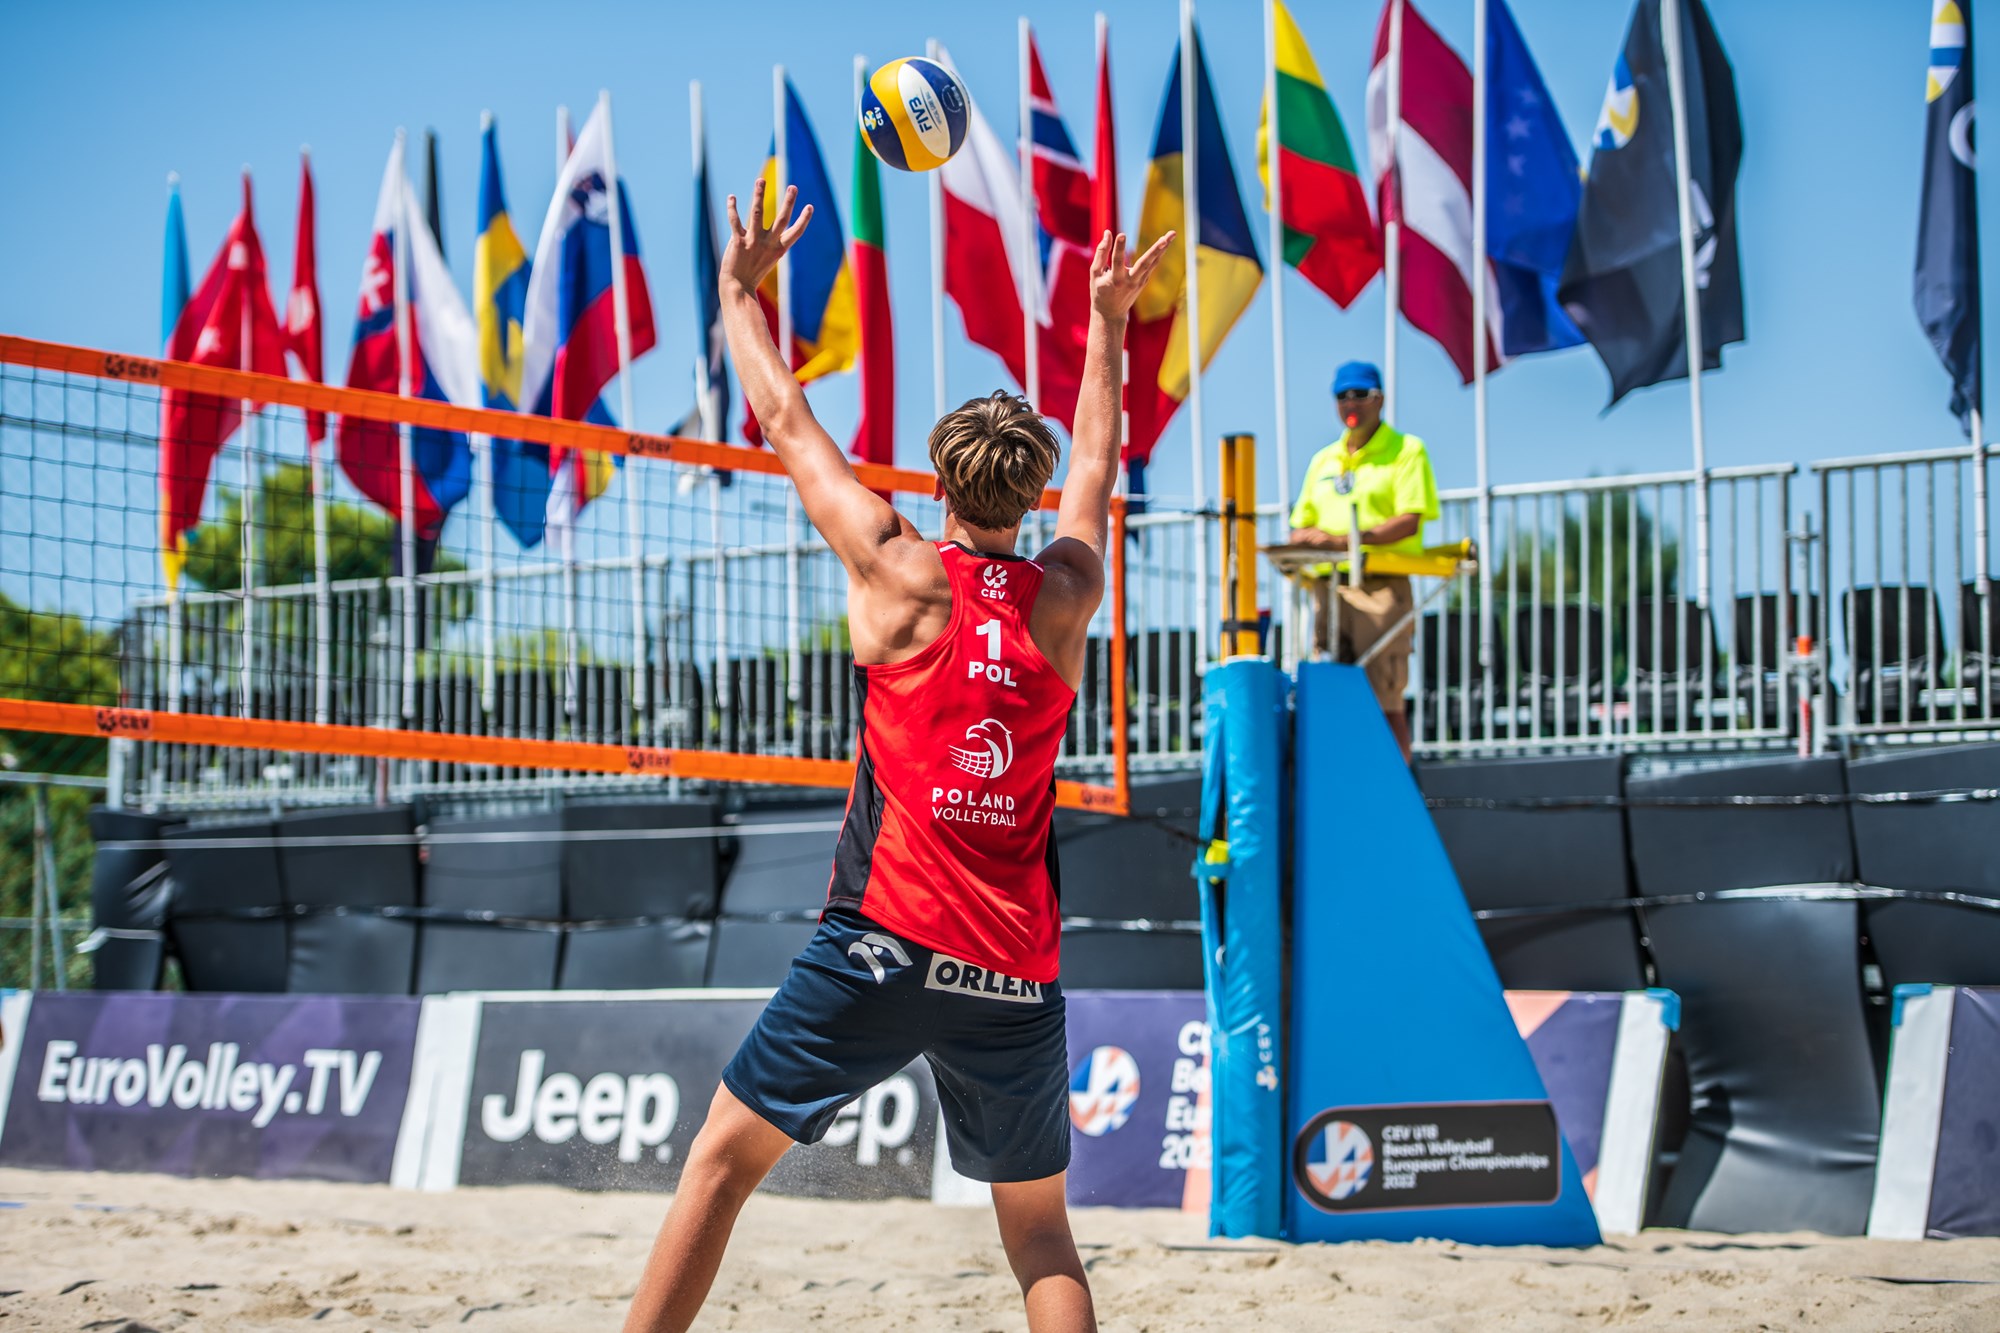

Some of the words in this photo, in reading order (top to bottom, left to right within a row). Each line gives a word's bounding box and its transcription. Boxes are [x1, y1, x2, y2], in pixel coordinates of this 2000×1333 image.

[874, 106, 884, 126] CEV
[908, 97, 932, 133] FIVB
[981, 588, 1006, 600] CEV
[976, 618, 1001, 661] 1
[968, 661, 1017, 687] POL
[932, 787, 1015, 811] POLAND
[932, 806, 1017, 827] VOLLEYBALL
[935, 961, 1037, 998] ORLEN
[1257, 1023, 1273, 1063] CEV
[37, 1040, 383, 1128] EuroVolley.TV
[1382, 1125, 1411, 1141] CEV
[1159, 1133, 1213, 1169] 202
[1382, 1141, 1426, 1157] Beach
[1428, 1138, 1494, 1156] Volleyball
[1382, 1157, 1448, 1173] European
[1449, 1153, 1549, 1173] Championships
